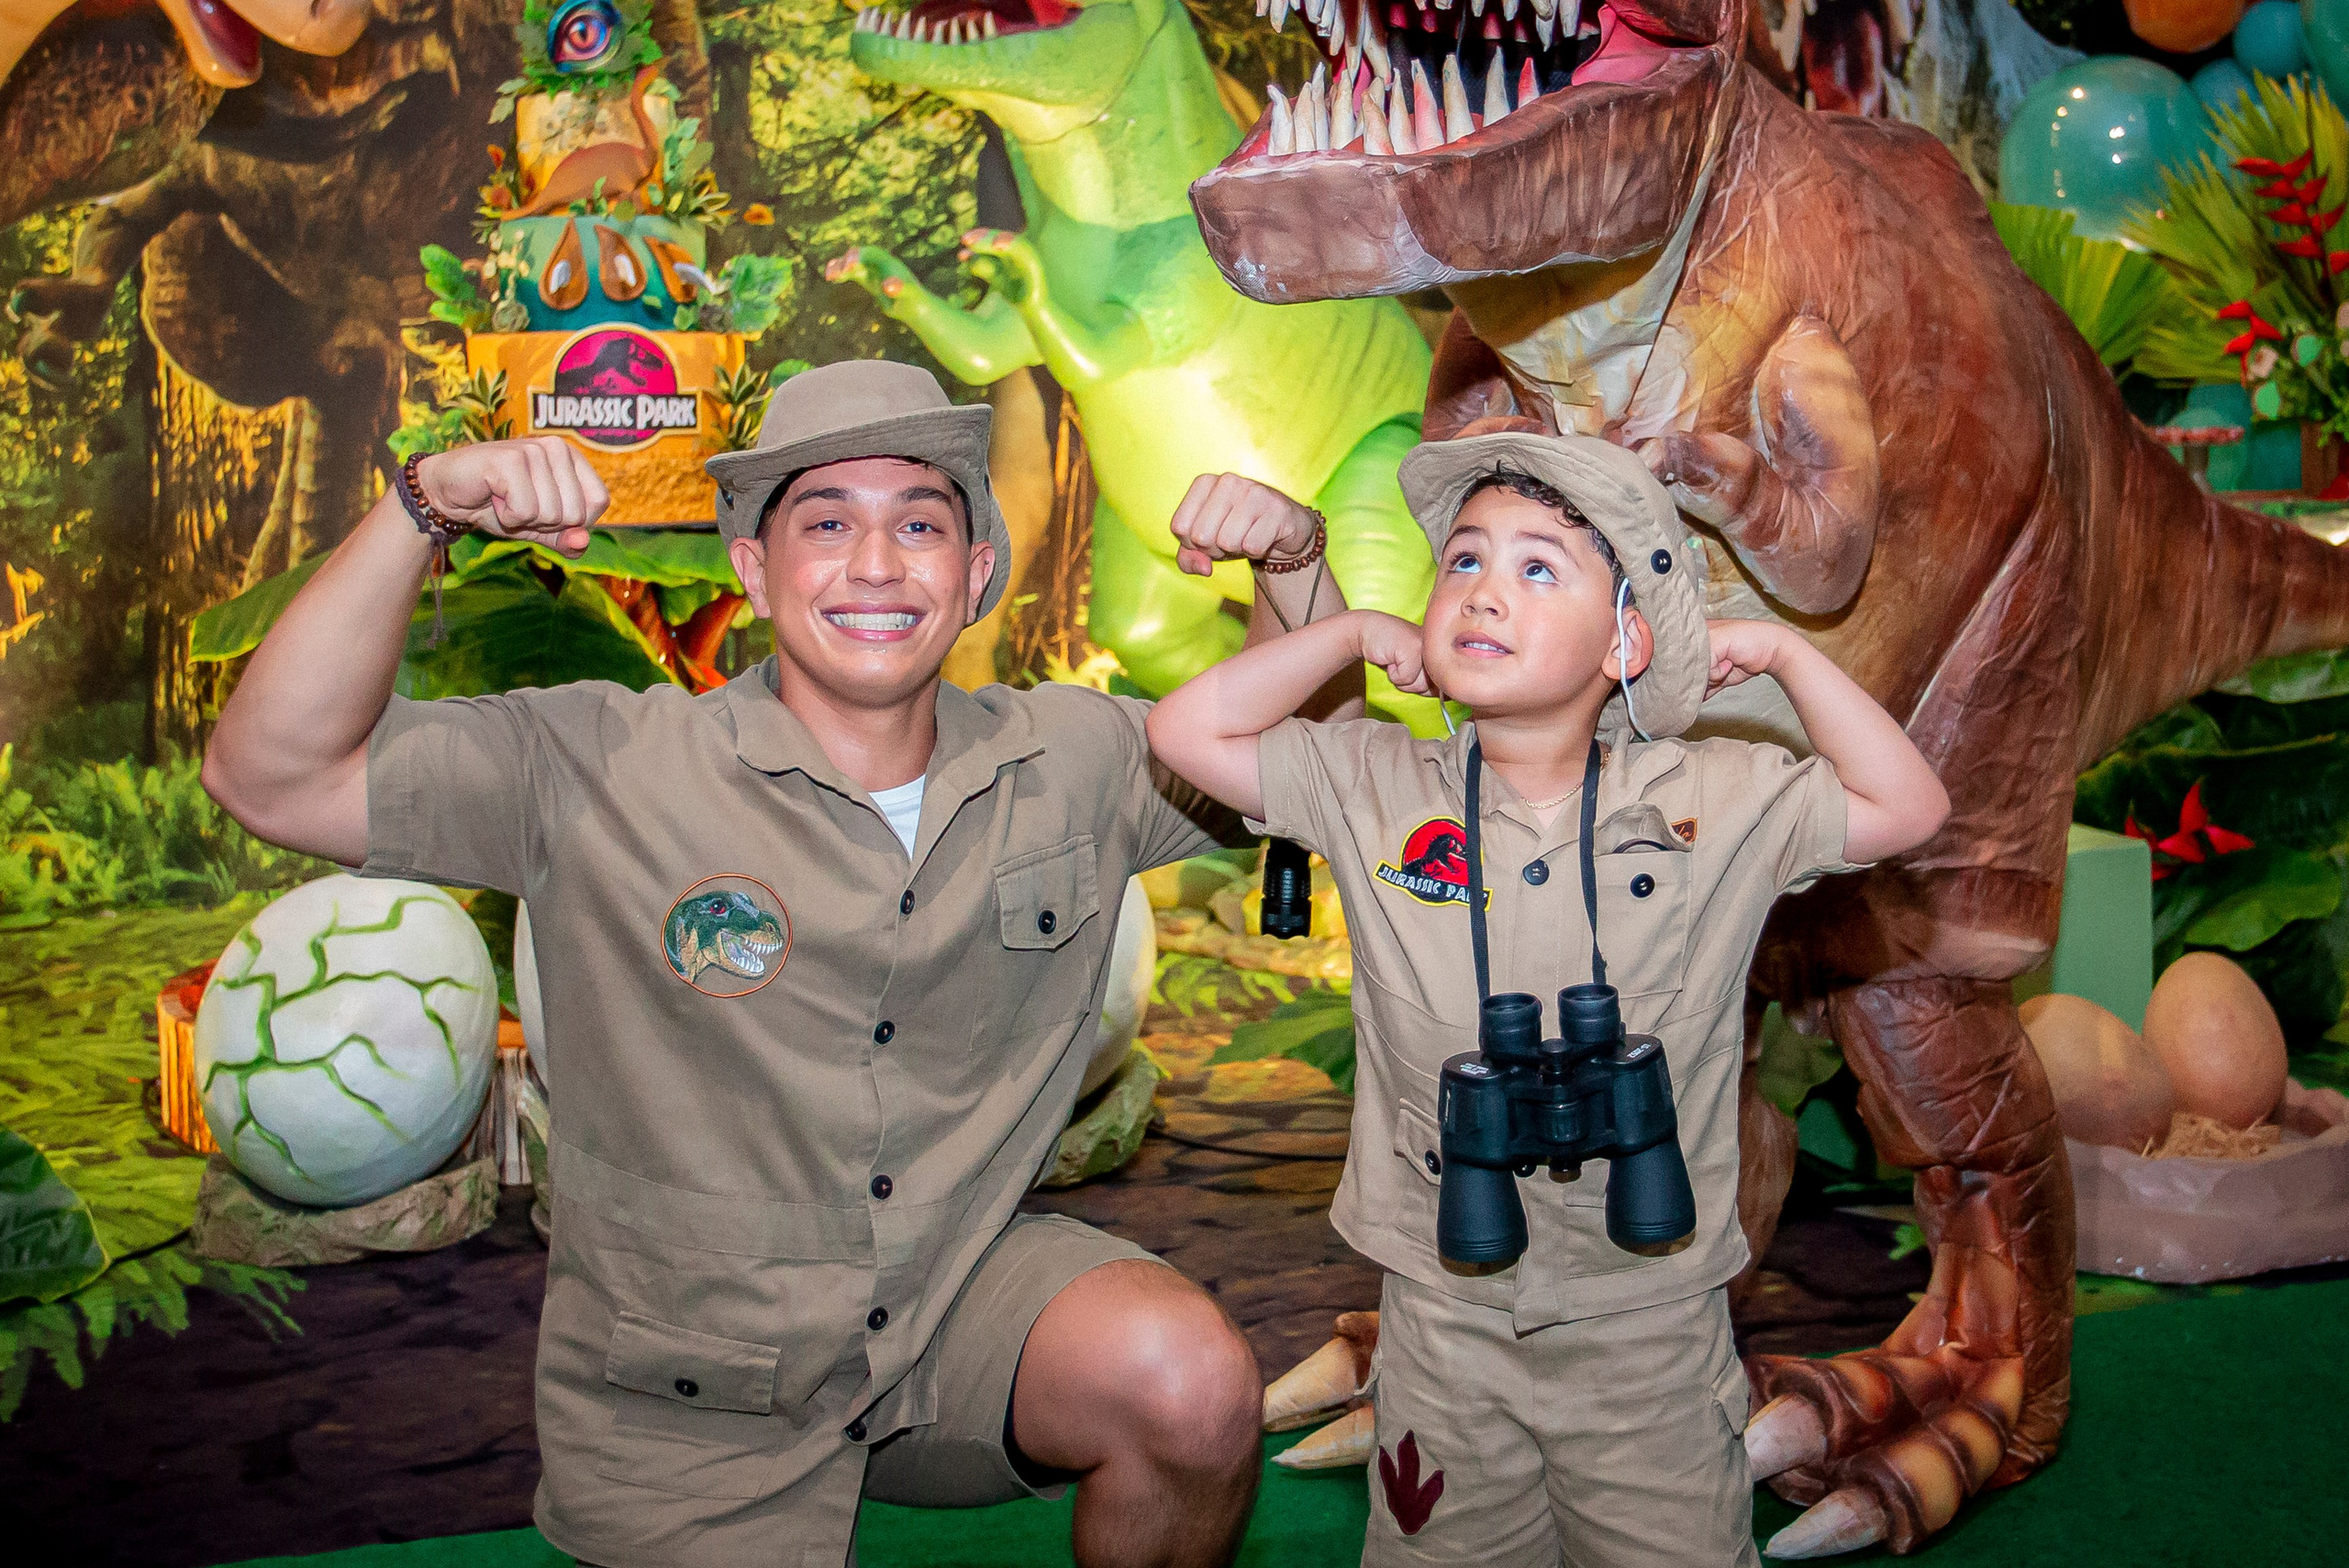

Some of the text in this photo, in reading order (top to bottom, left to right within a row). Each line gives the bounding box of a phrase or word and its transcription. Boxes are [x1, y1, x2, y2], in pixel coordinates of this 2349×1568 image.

[534, 395, 696, 429] JURASSIC PARK
[1377, 866, 1487, 903] JURASSIC PA
